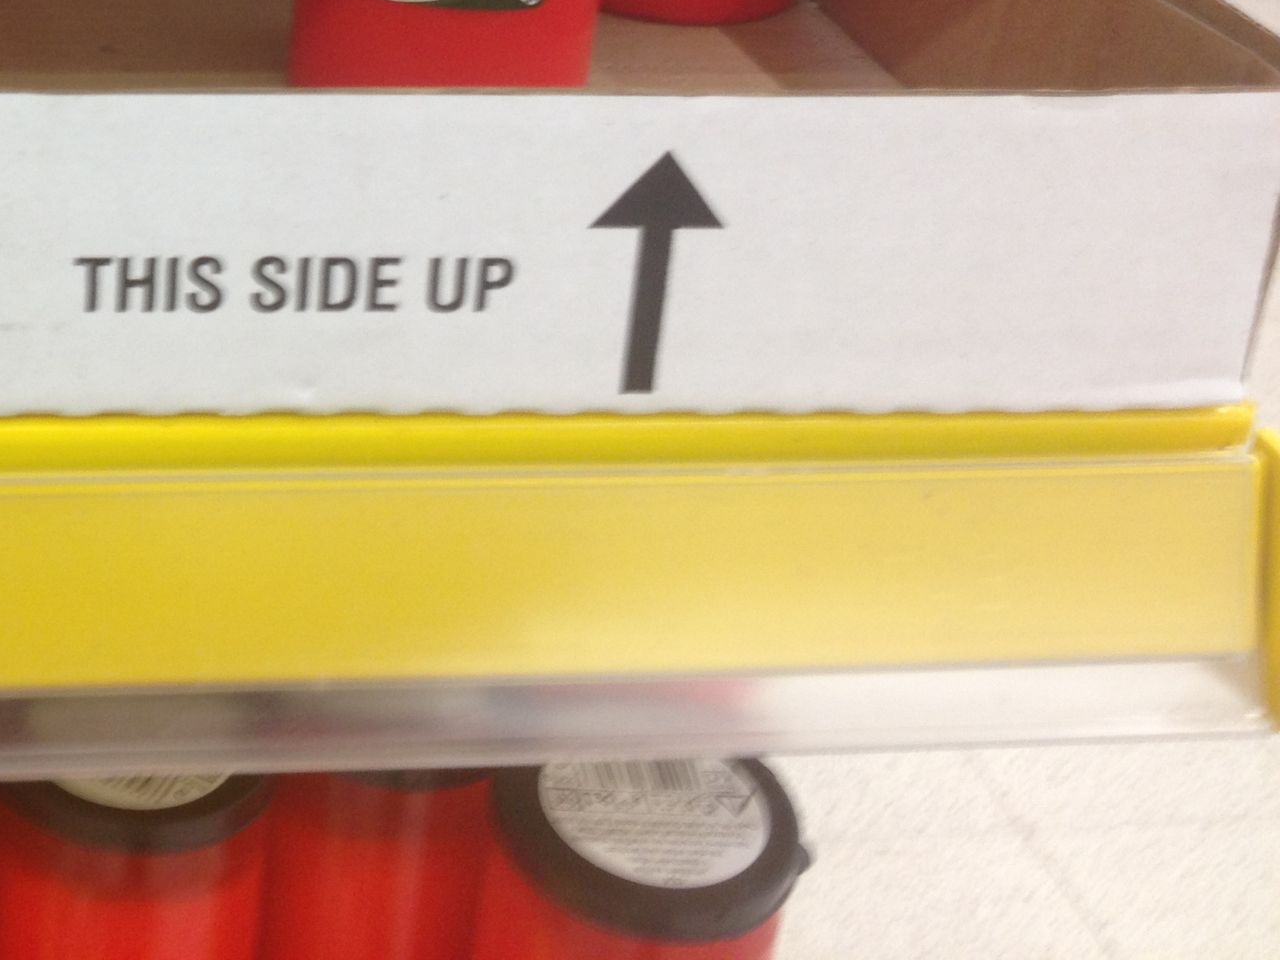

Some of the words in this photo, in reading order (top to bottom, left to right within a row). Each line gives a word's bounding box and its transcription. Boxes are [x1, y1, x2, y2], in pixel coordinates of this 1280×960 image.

[73, 254, 226, 315] THIS
[249, 254, 403, 315] SIDE
[424, 254, 520, 314] UP
